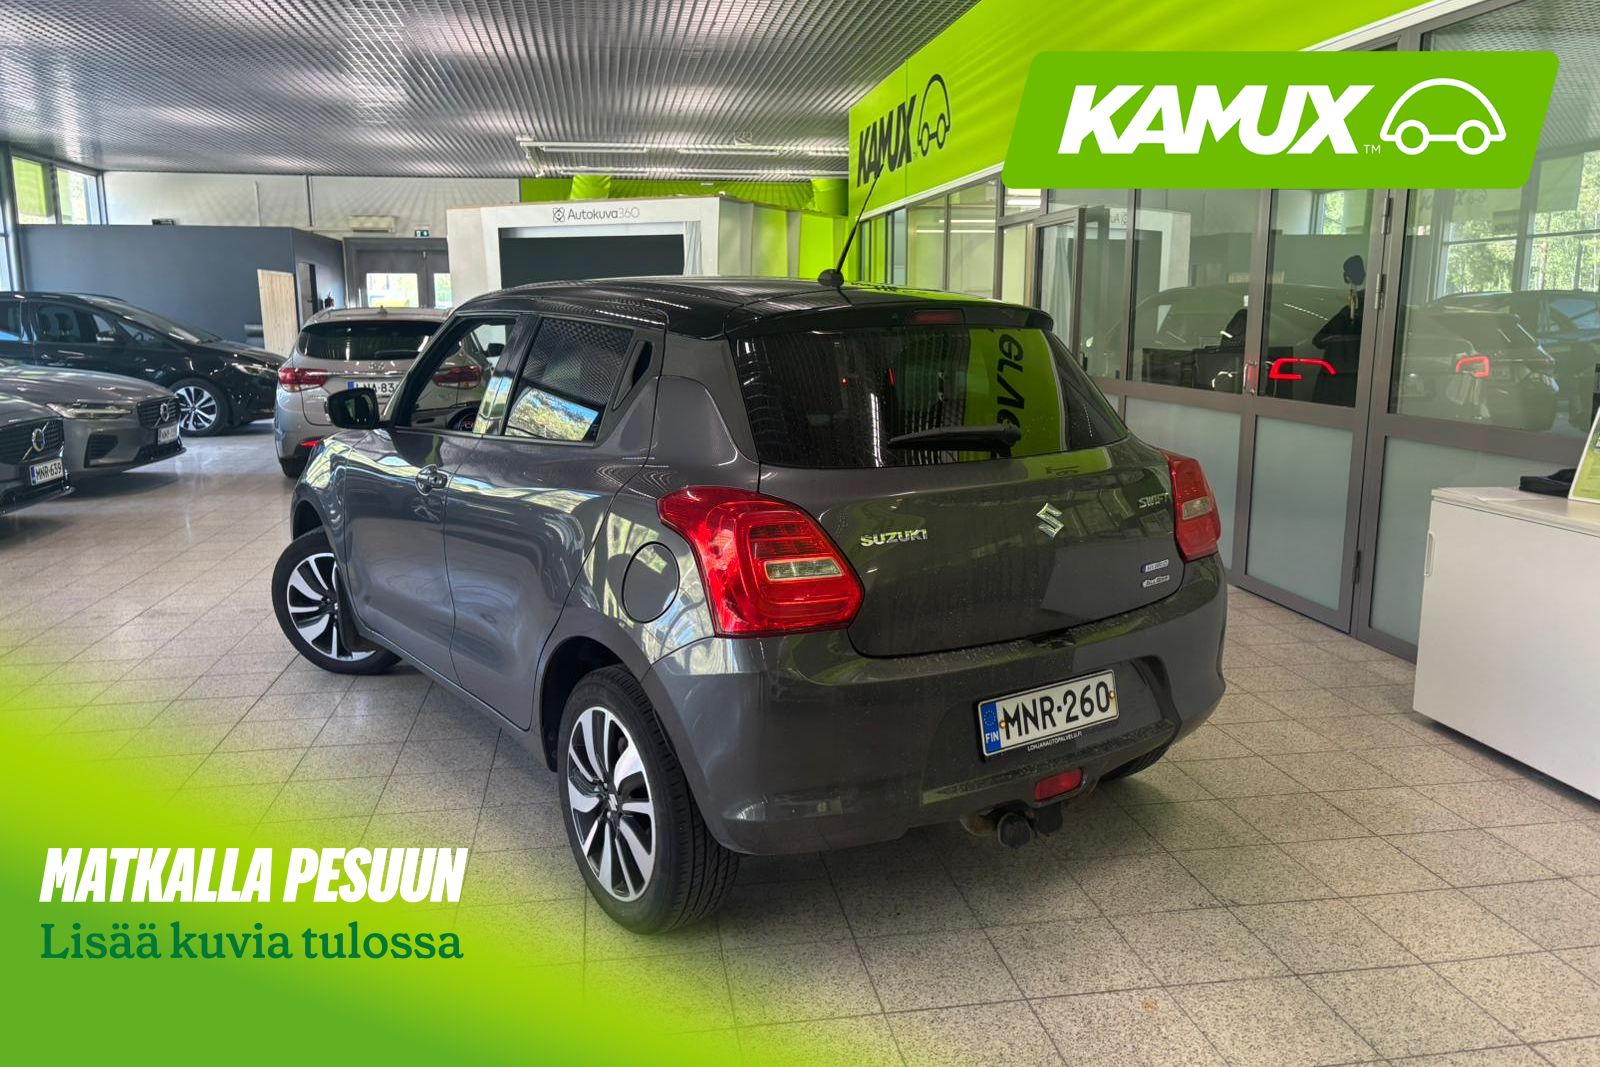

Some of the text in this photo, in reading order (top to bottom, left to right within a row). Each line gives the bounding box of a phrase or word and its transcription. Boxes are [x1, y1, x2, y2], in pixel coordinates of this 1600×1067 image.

[857, 94, 917, 188] KAMUX
[567, 207, 640, 221] Autokuva360
[860, 528, 928, 547] SUZUKI
[985, 681, 1110, 744] FIN MNR-260
